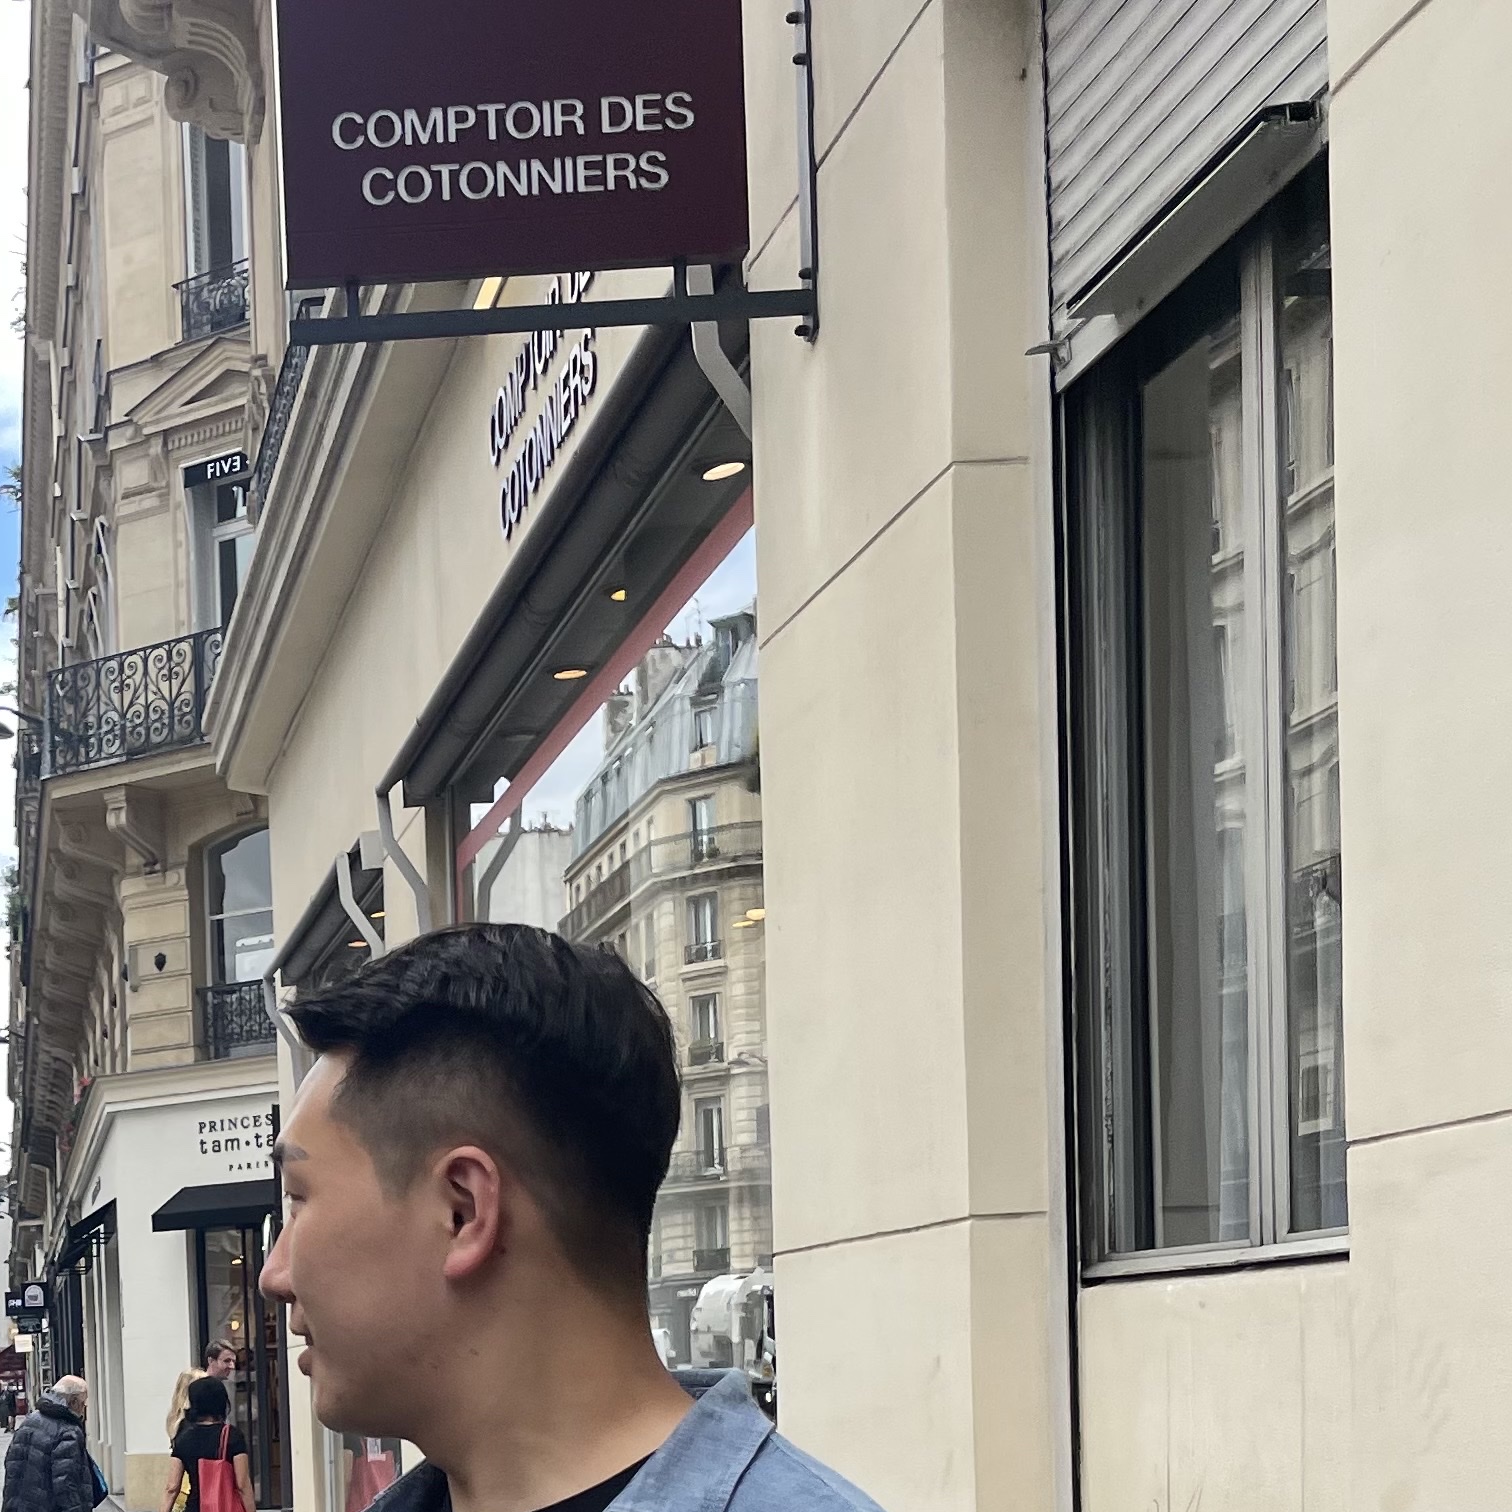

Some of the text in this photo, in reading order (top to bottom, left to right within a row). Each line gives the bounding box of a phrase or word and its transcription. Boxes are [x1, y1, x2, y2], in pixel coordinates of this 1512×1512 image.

[331, 91, 695, 151] COMPTOIR DES
[361, 150, 670, 206] COTONNIERS
[499, 329, 596, 541] COTONNIERS
